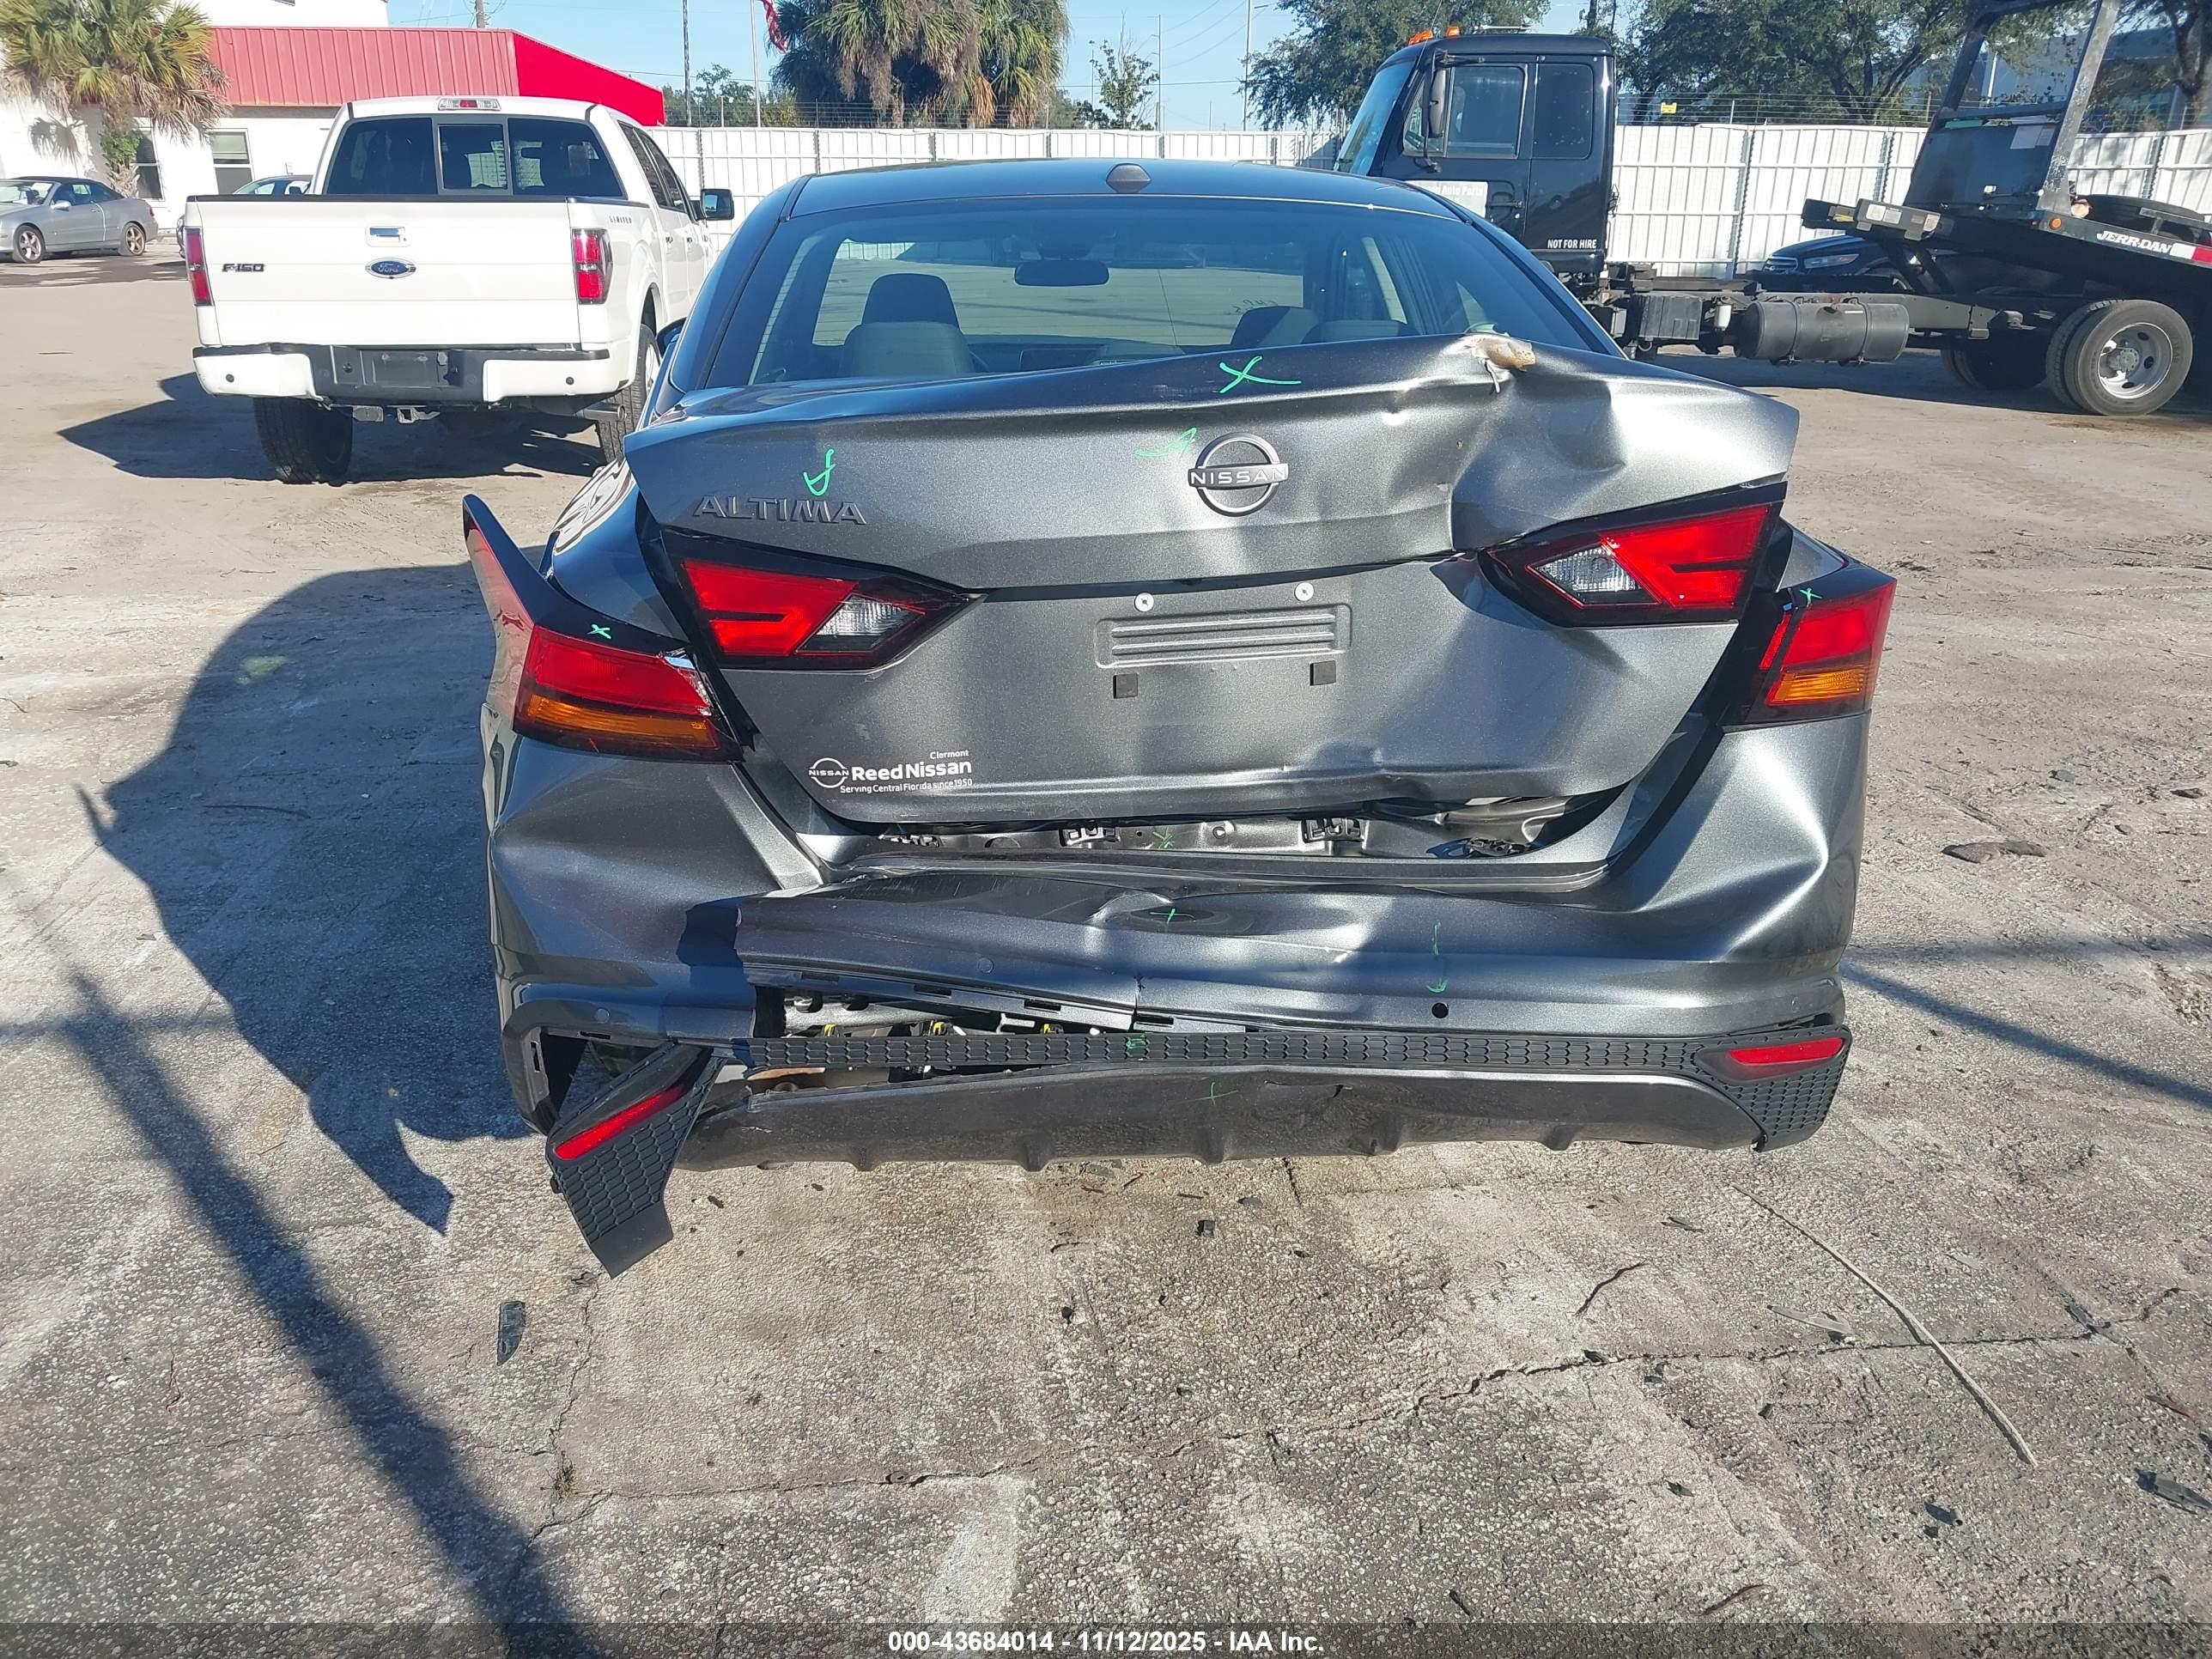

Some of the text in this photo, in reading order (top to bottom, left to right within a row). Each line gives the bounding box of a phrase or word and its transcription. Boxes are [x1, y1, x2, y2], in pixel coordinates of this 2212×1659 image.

[1547, 239, 1597, 249] NOT FOR HIRE
[378, 263, 398, 273] Ford
[1190, 469, 1286, 484] NISSAN
[693, 495, 867, 526] ALTIMA
[929, 750, 969, 760] Clermont
[851, 761, 972, 781] Reed Nissan
[840, 785, 872, 794] Serving
[872, 783, 902, 793] Central
[902, 781, 932, 791] Florida
